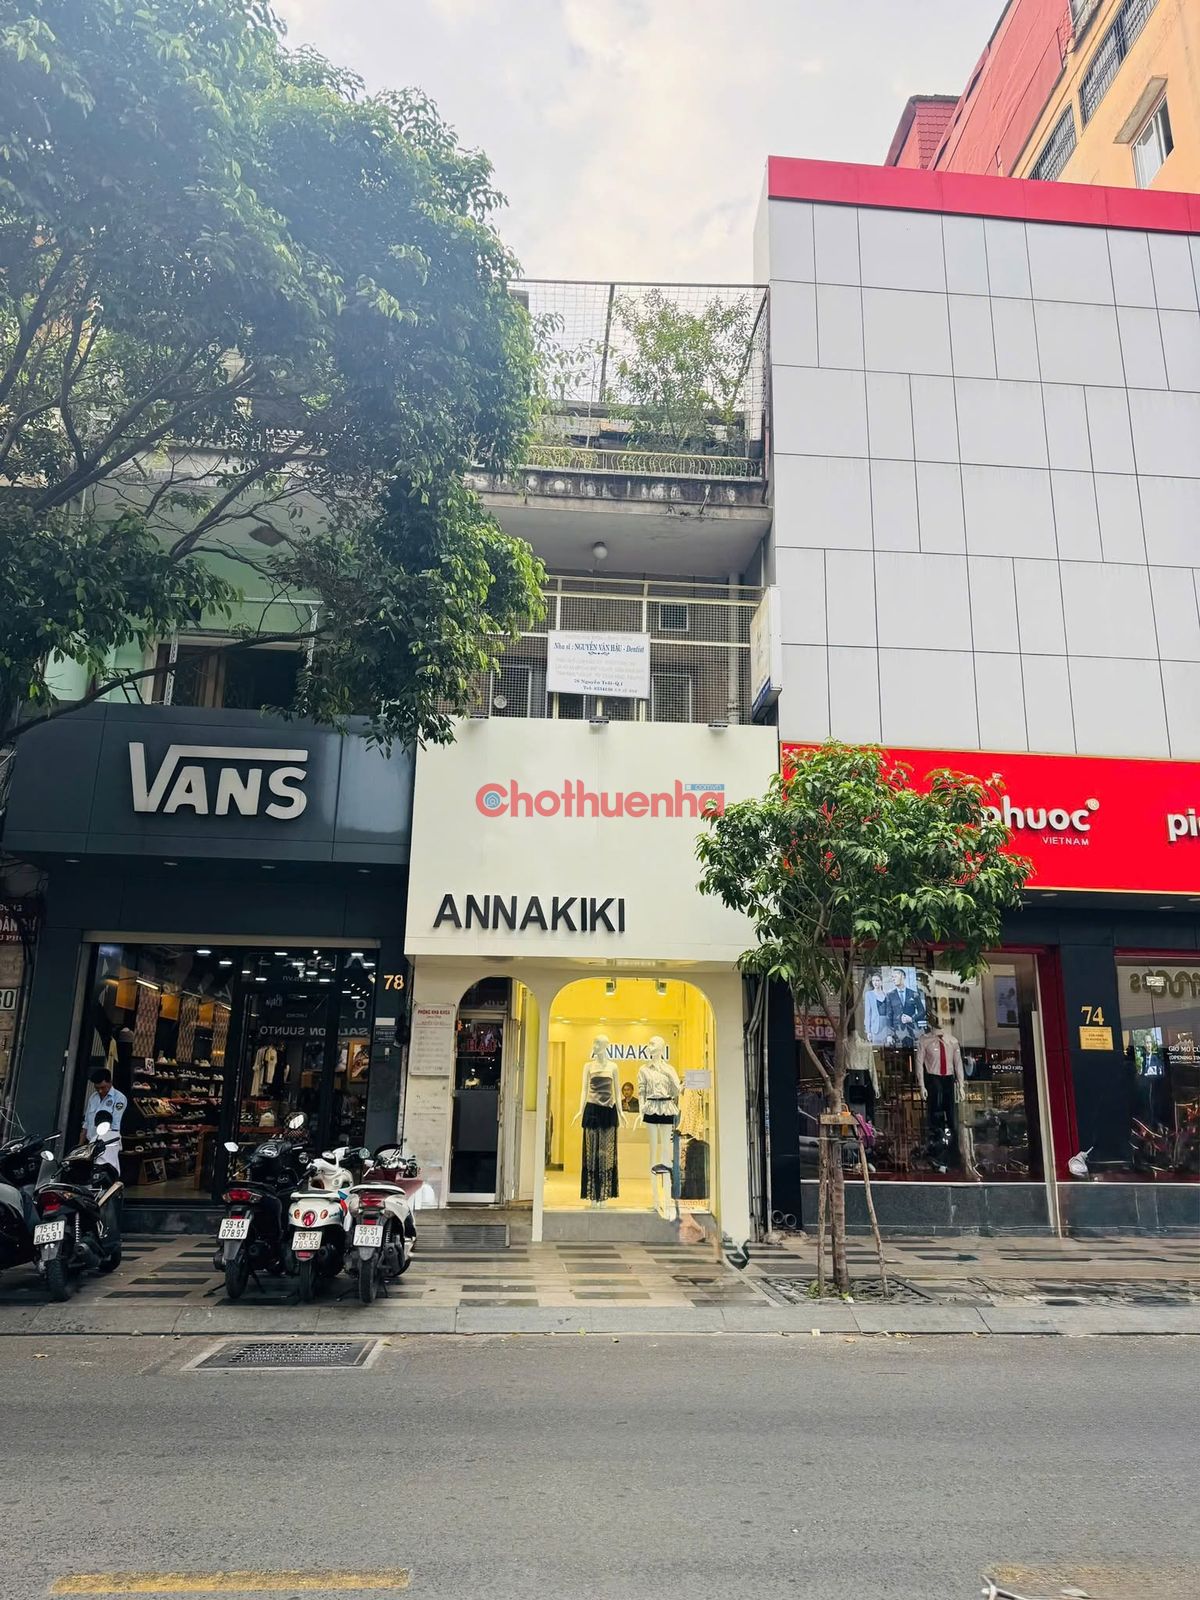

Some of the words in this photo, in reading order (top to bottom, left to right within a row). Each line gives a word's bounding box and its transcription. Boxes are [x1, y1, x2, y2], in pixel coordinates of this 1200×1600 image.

[128, 741, 309, 820] VANS
[1166, 807, 1200, 842] pi
[1042, 836, 1090, 847] VIETNAM
[432, 893, 626, 933] ANNAKIKI
[383, 974, 405, 990] 78
[1081, 1006, 1104, 1025] 74
